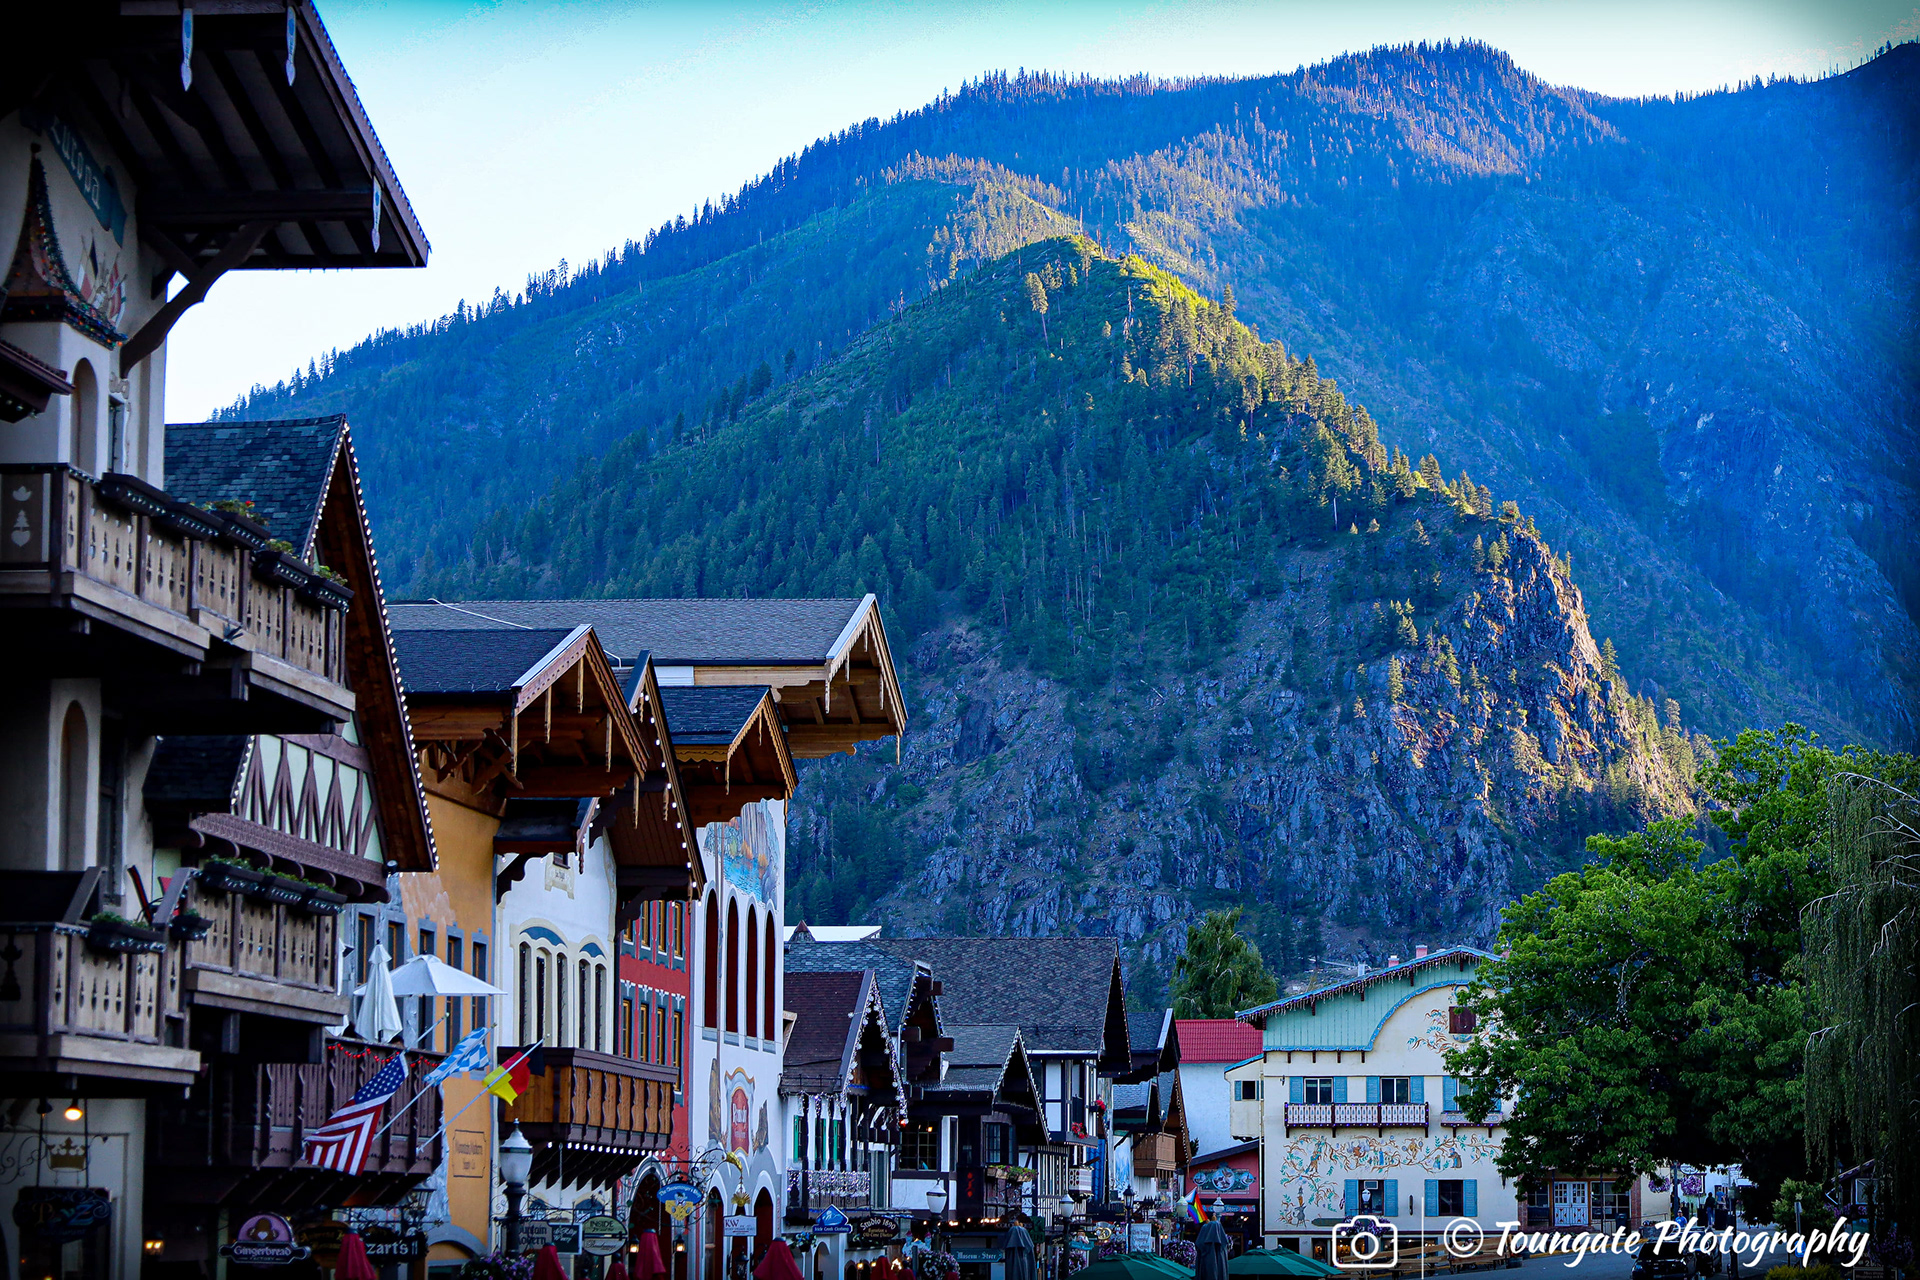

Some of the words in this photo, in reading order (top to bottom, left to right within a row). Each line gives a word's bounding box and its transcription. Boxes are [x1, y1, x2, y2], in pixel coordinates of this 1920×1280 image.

[860, 1217, 881, 1230] Studio
[882, 1218, 896, 1230] 1890
[233, 1245, 292, 1256] Gingerbread
[366, 1239, 409, 1255] zart's
